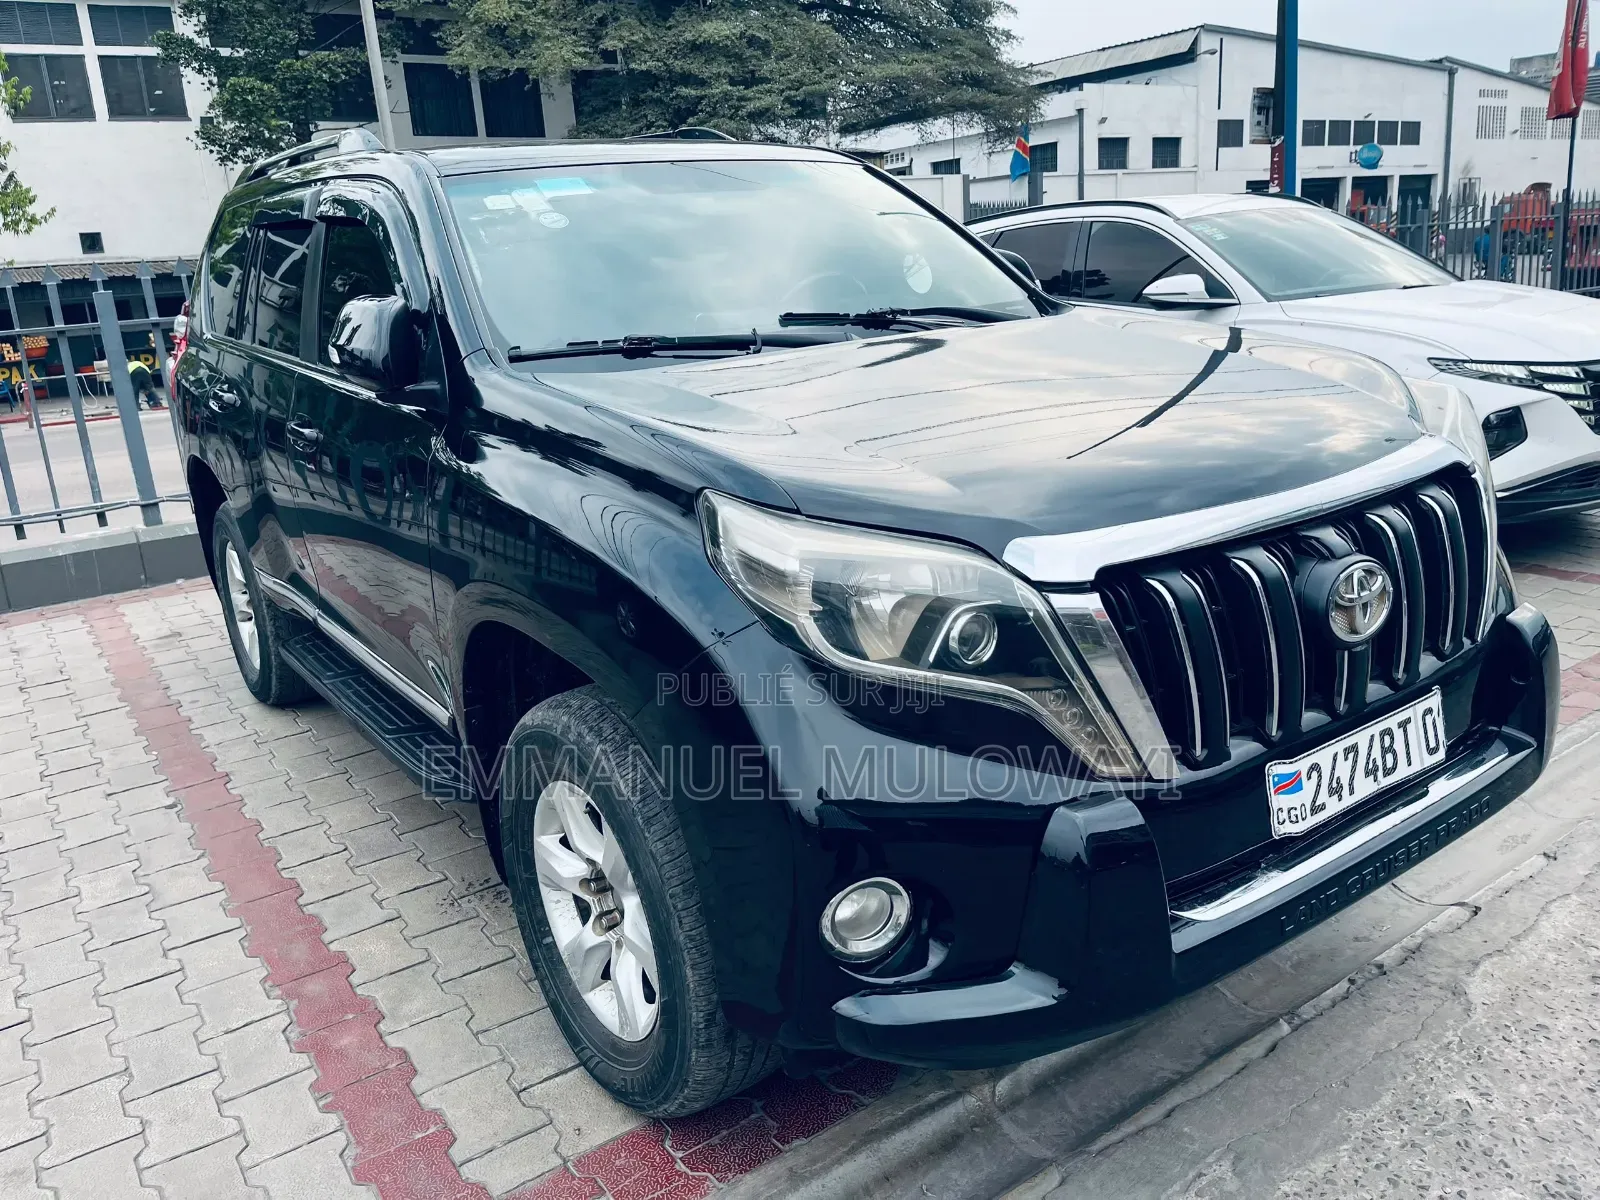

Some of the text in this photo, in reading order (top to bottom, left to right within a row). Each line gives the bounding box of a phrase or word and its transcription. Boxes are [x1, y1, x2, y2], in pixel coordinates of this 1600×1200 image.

[1306, 716, 1412, 817] 2474BT
[1280, 795, 1490, 936] LAND CRUISER PRADO
